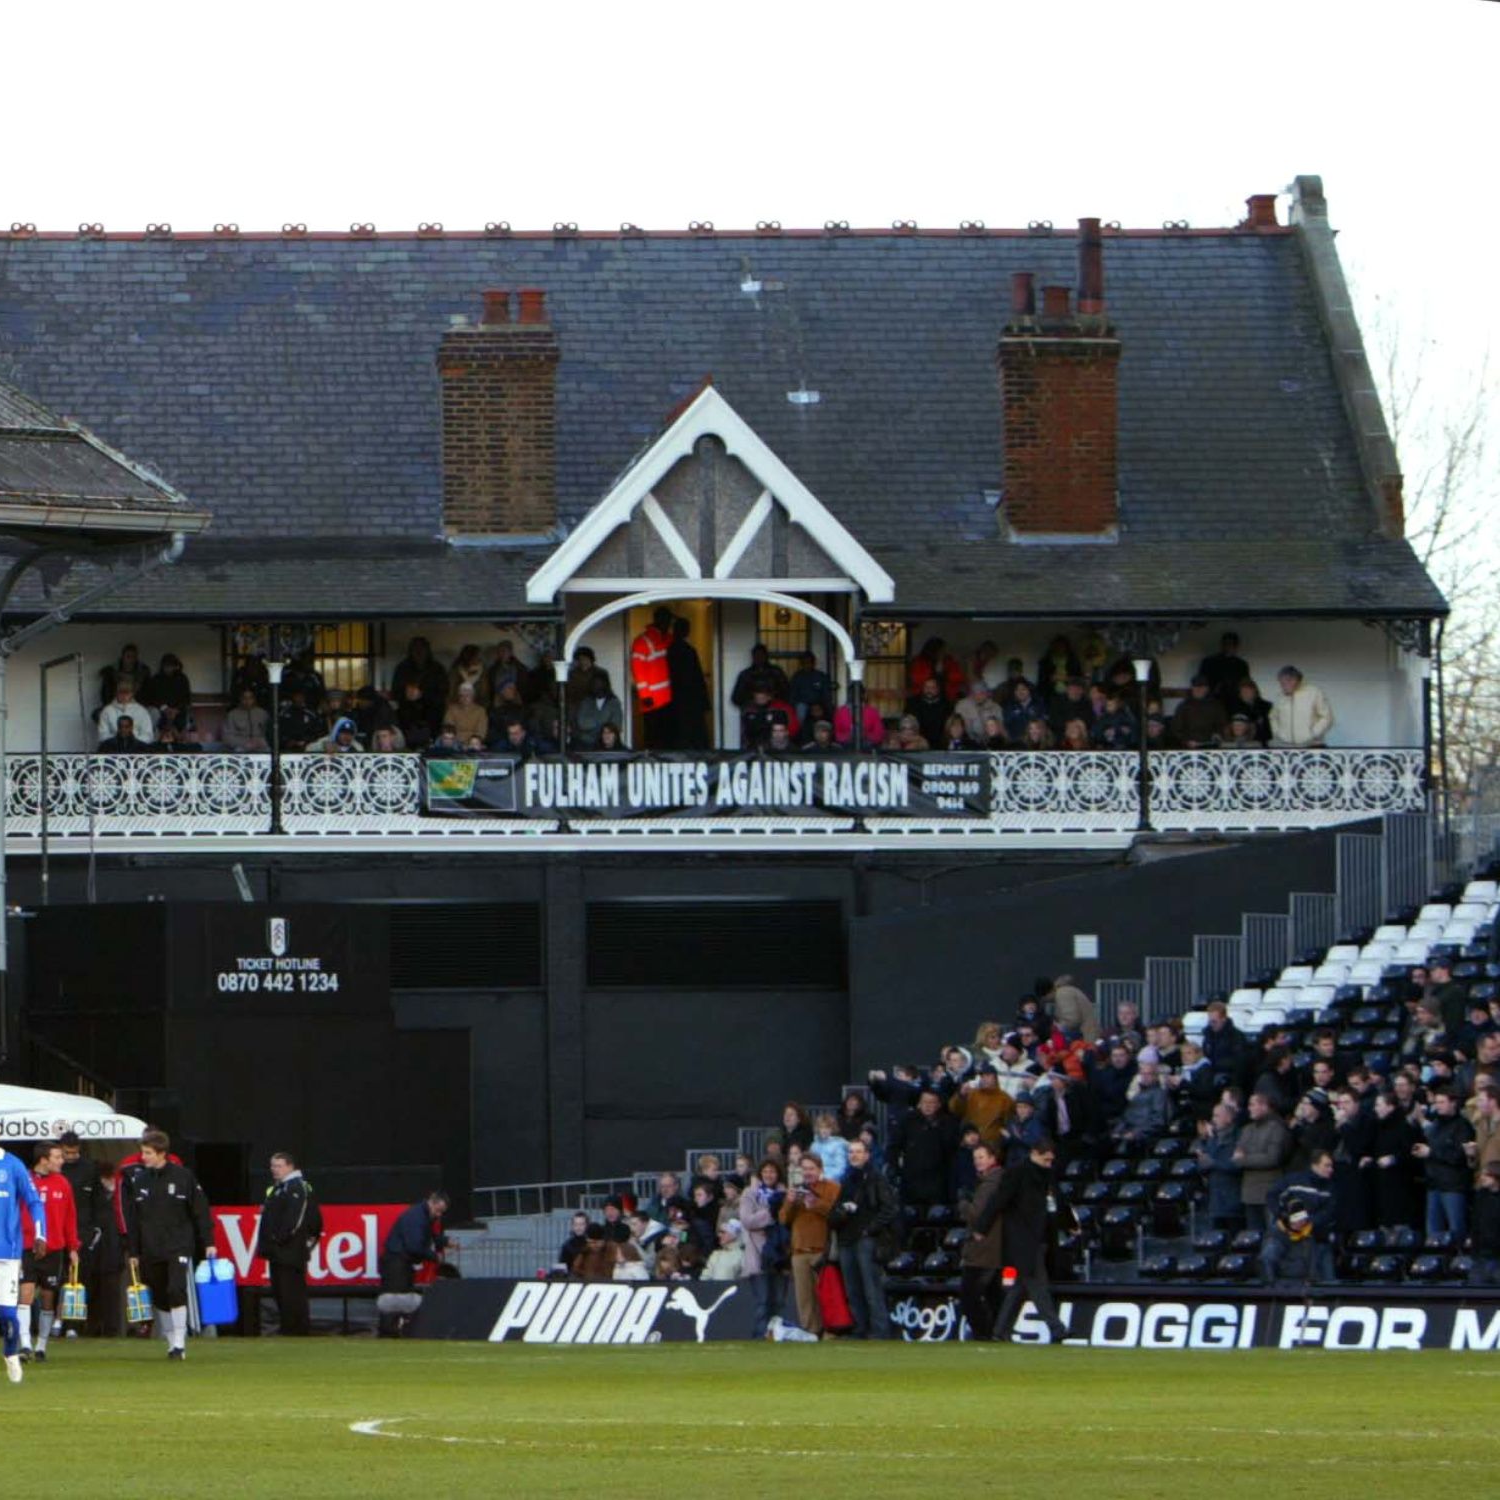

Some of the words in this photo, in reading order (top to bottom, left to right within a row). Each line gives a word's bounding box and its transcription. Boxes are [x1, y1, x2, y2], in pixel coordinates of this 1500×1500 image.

[922, 763, 966, 776] REPORT
[969, 764, 980, 776] IT
[524, 762, 620, 808] FULHAM
[627, 762, 708, 806] UNITES
[715, 761, 816, 806] AGAINST
[823, 762, 908, 807] RACISM
[921, 780, 956, 795] 0800
[237, 958, 273, 970] TICKET
[275, 958, 320, 970] HOTLINE
[217, 973, 259, 991] 0870
[263, 973, 294, 991] 442
[298, 973, 339, 991] 1234
[488, 1281, 668, 1344] PUMA
[1279, 1305, 1427, 1350] FOR
